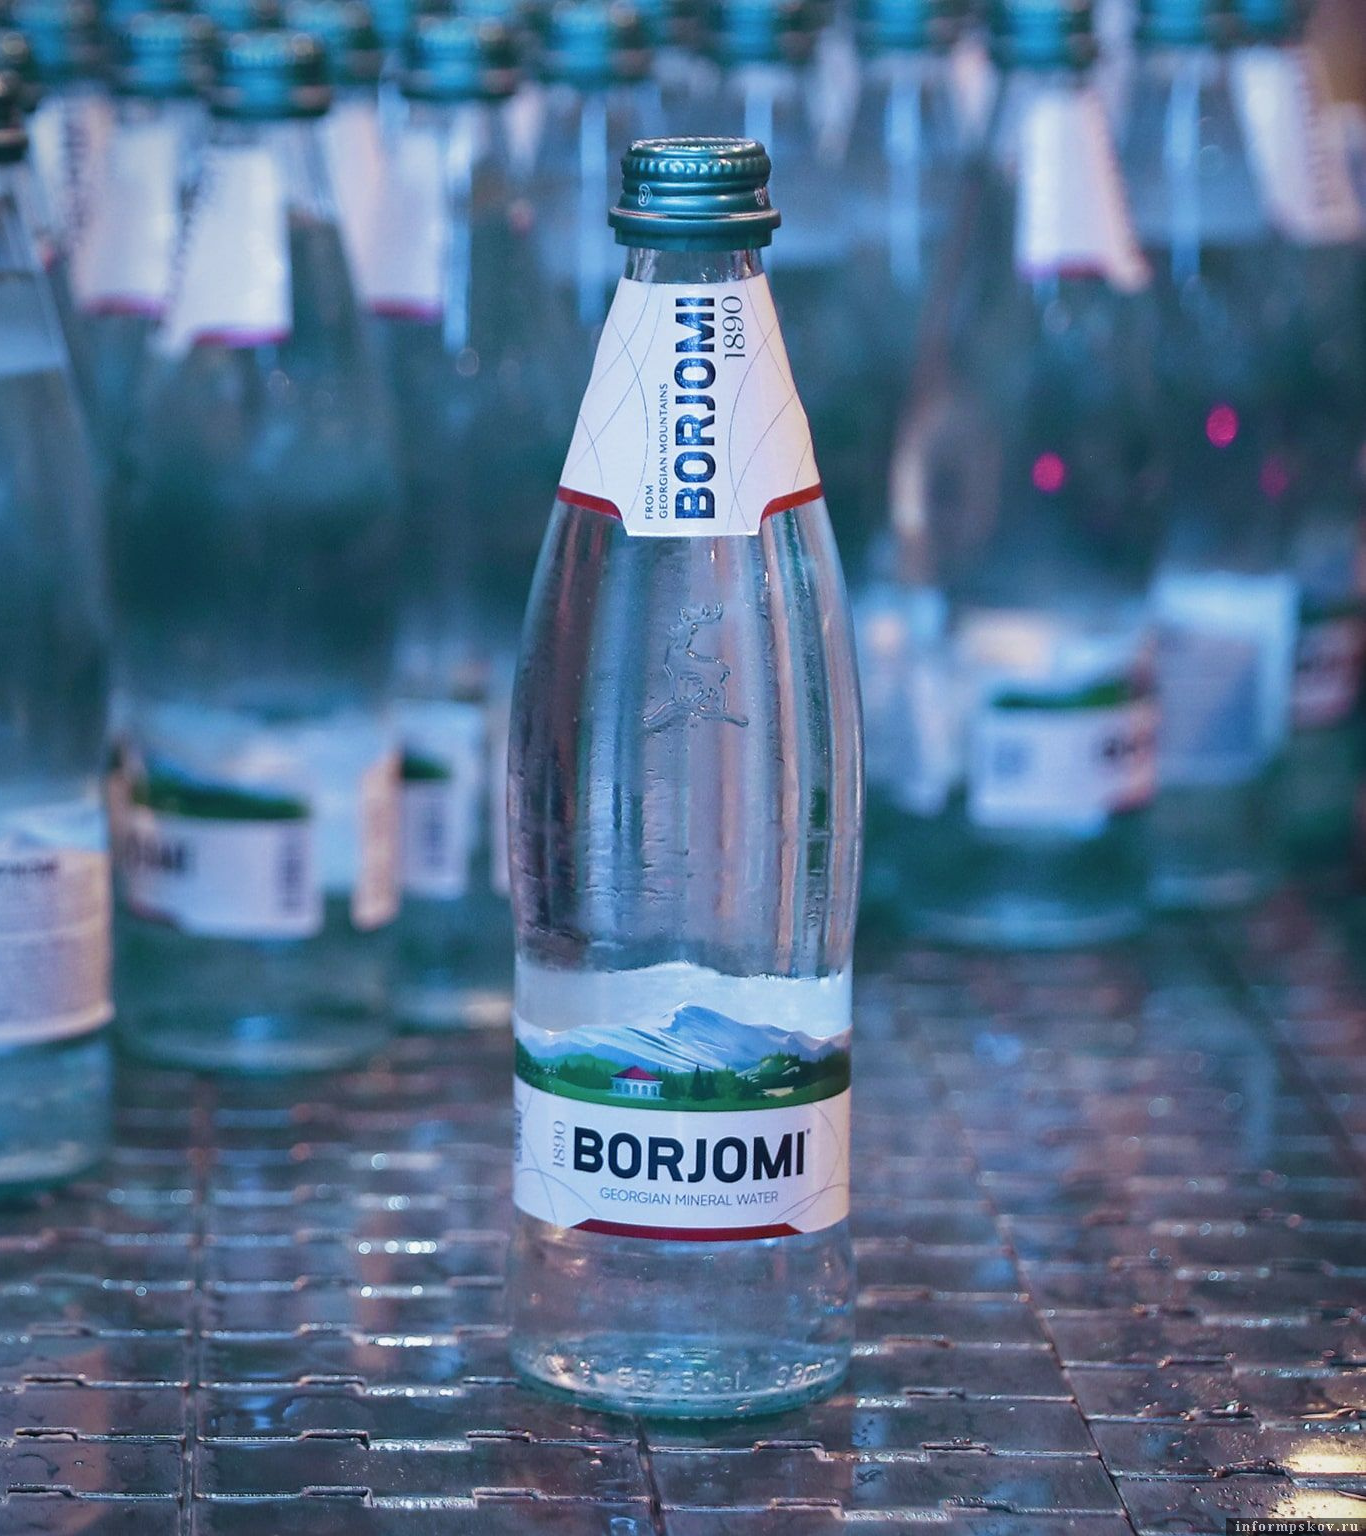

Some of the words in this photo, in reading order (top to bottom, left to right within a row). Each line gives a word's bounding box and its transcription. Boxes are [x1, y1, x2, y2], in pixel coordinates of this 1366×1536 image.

[722, 295, 745, 359] 1890
[659, 383, 668, 453] MOUNTAINS
[674, 297, 716, 518] BORJOMI
[645, 484, 654, 519] FROM
[659, 457, 668, 518] GEORGIAN
[552, 1120, 566, 1168] 1890
[573, 1126, 805, 1183] BORJOMI
[600, 1187, 671, 1206] GEORGIAN
[676, 1191, 732, 1206] MINERAL
[736, 1190, 779, 1205] WATER
